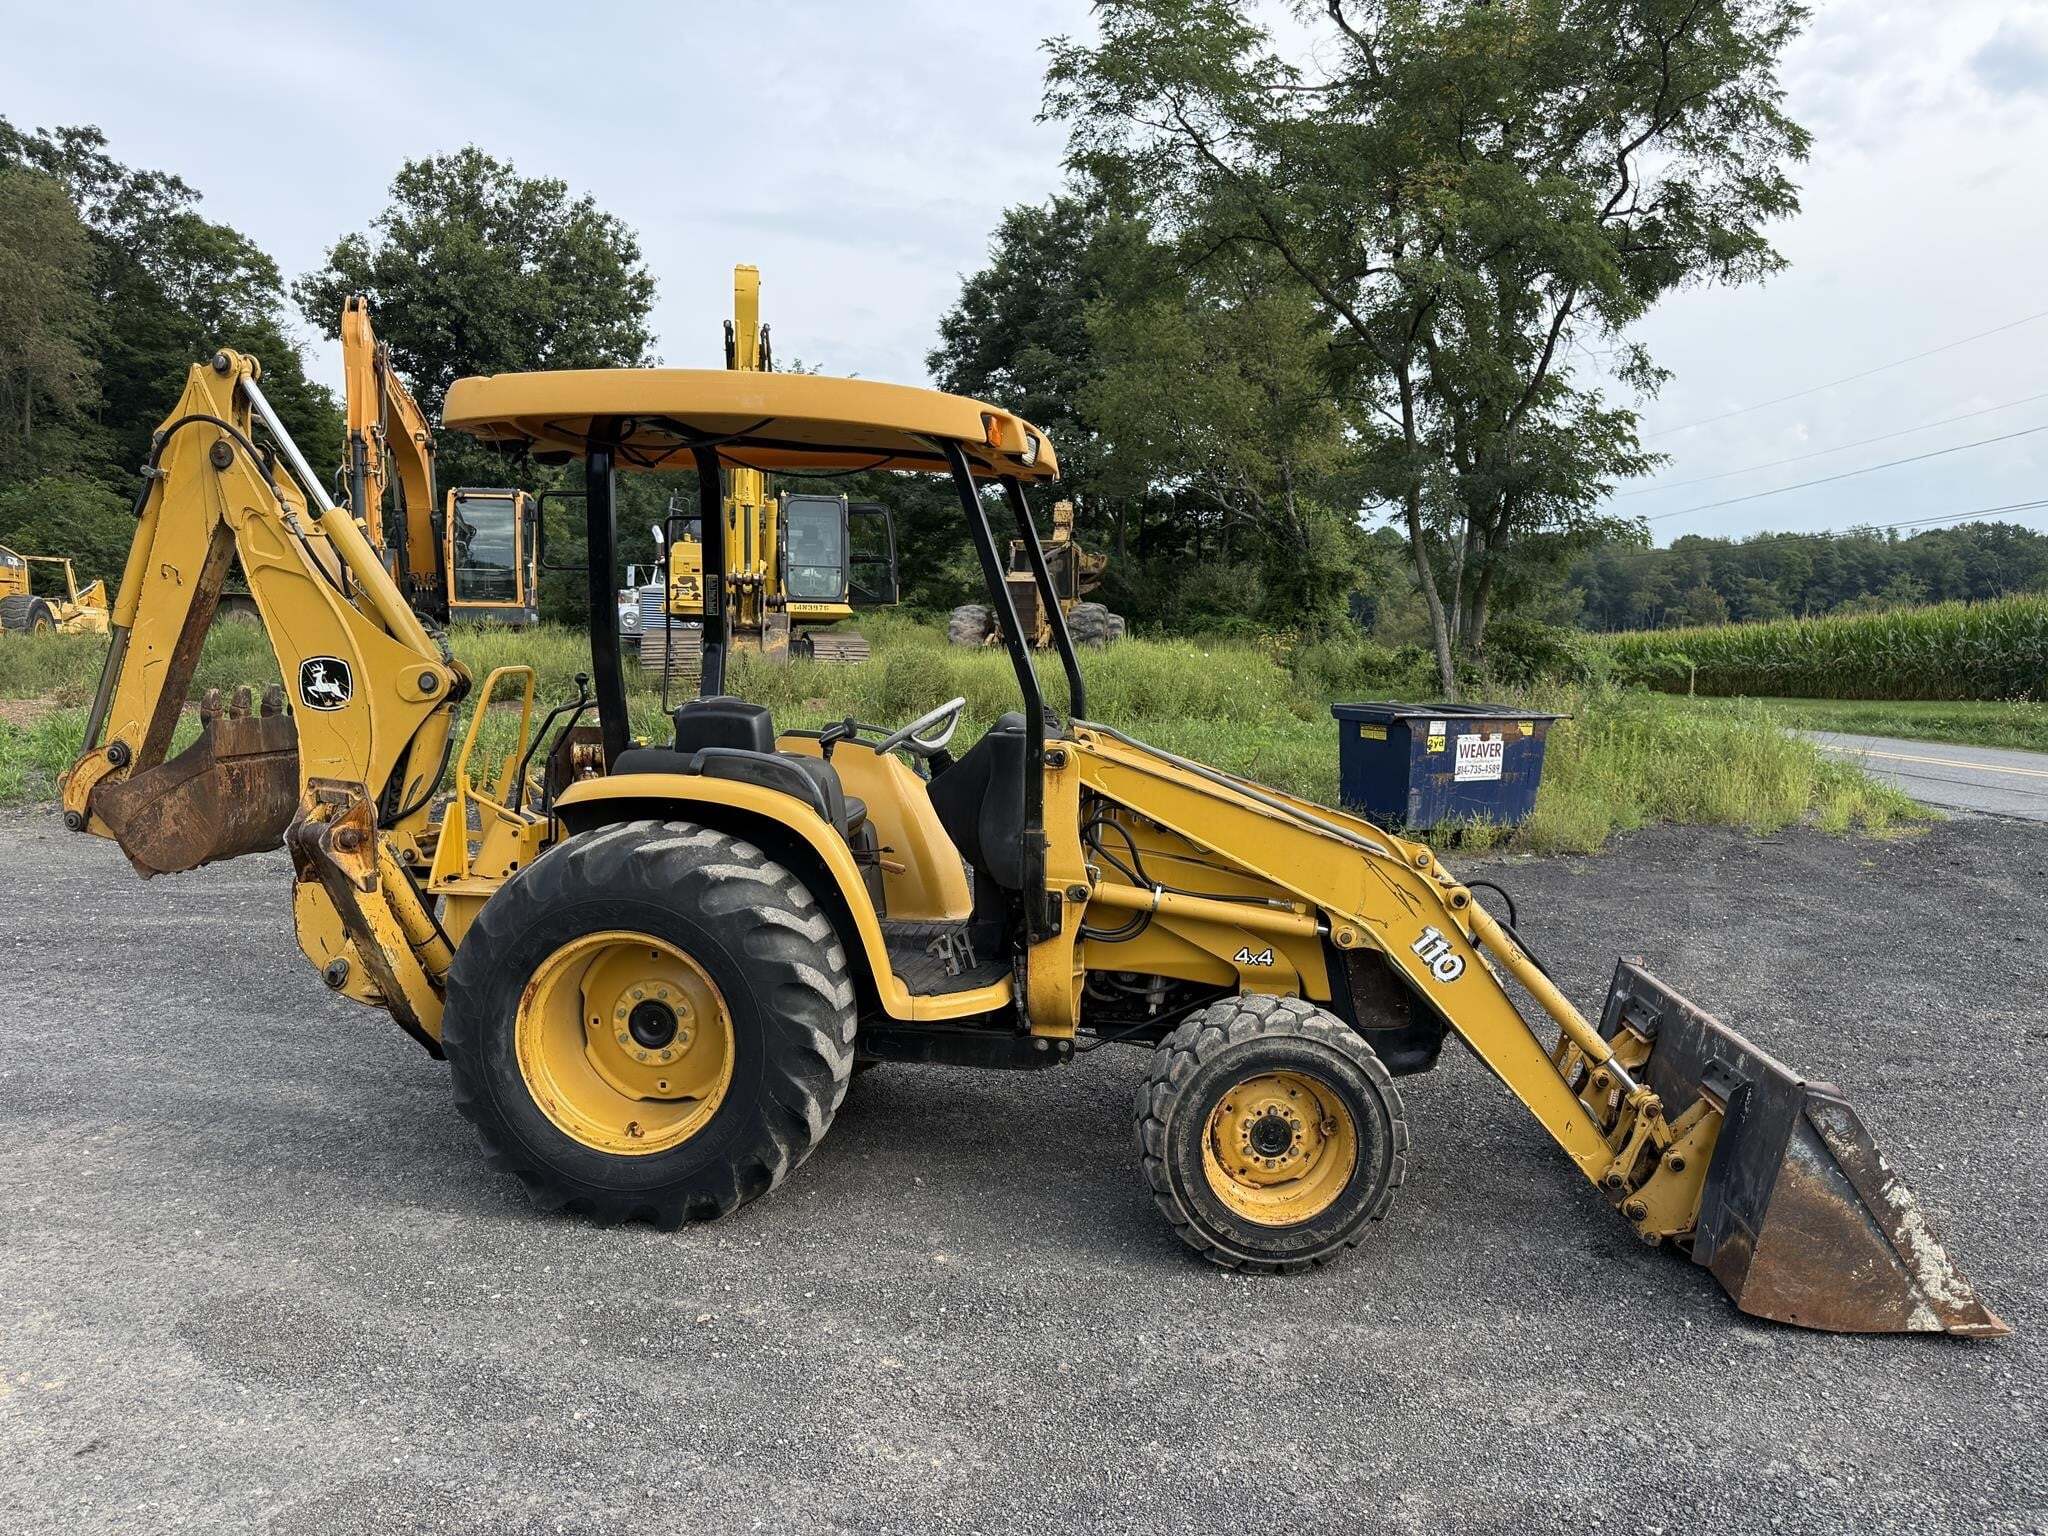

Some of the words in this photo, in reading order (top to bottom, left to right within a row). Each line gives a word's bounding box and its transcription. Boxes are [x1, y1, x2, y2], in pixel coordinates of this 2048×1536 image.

[1459, 743, 1502, 758] WEAVER
[1234, 947, 1273, 966] 4x4
[1410, 926, 1466, 982] 110
